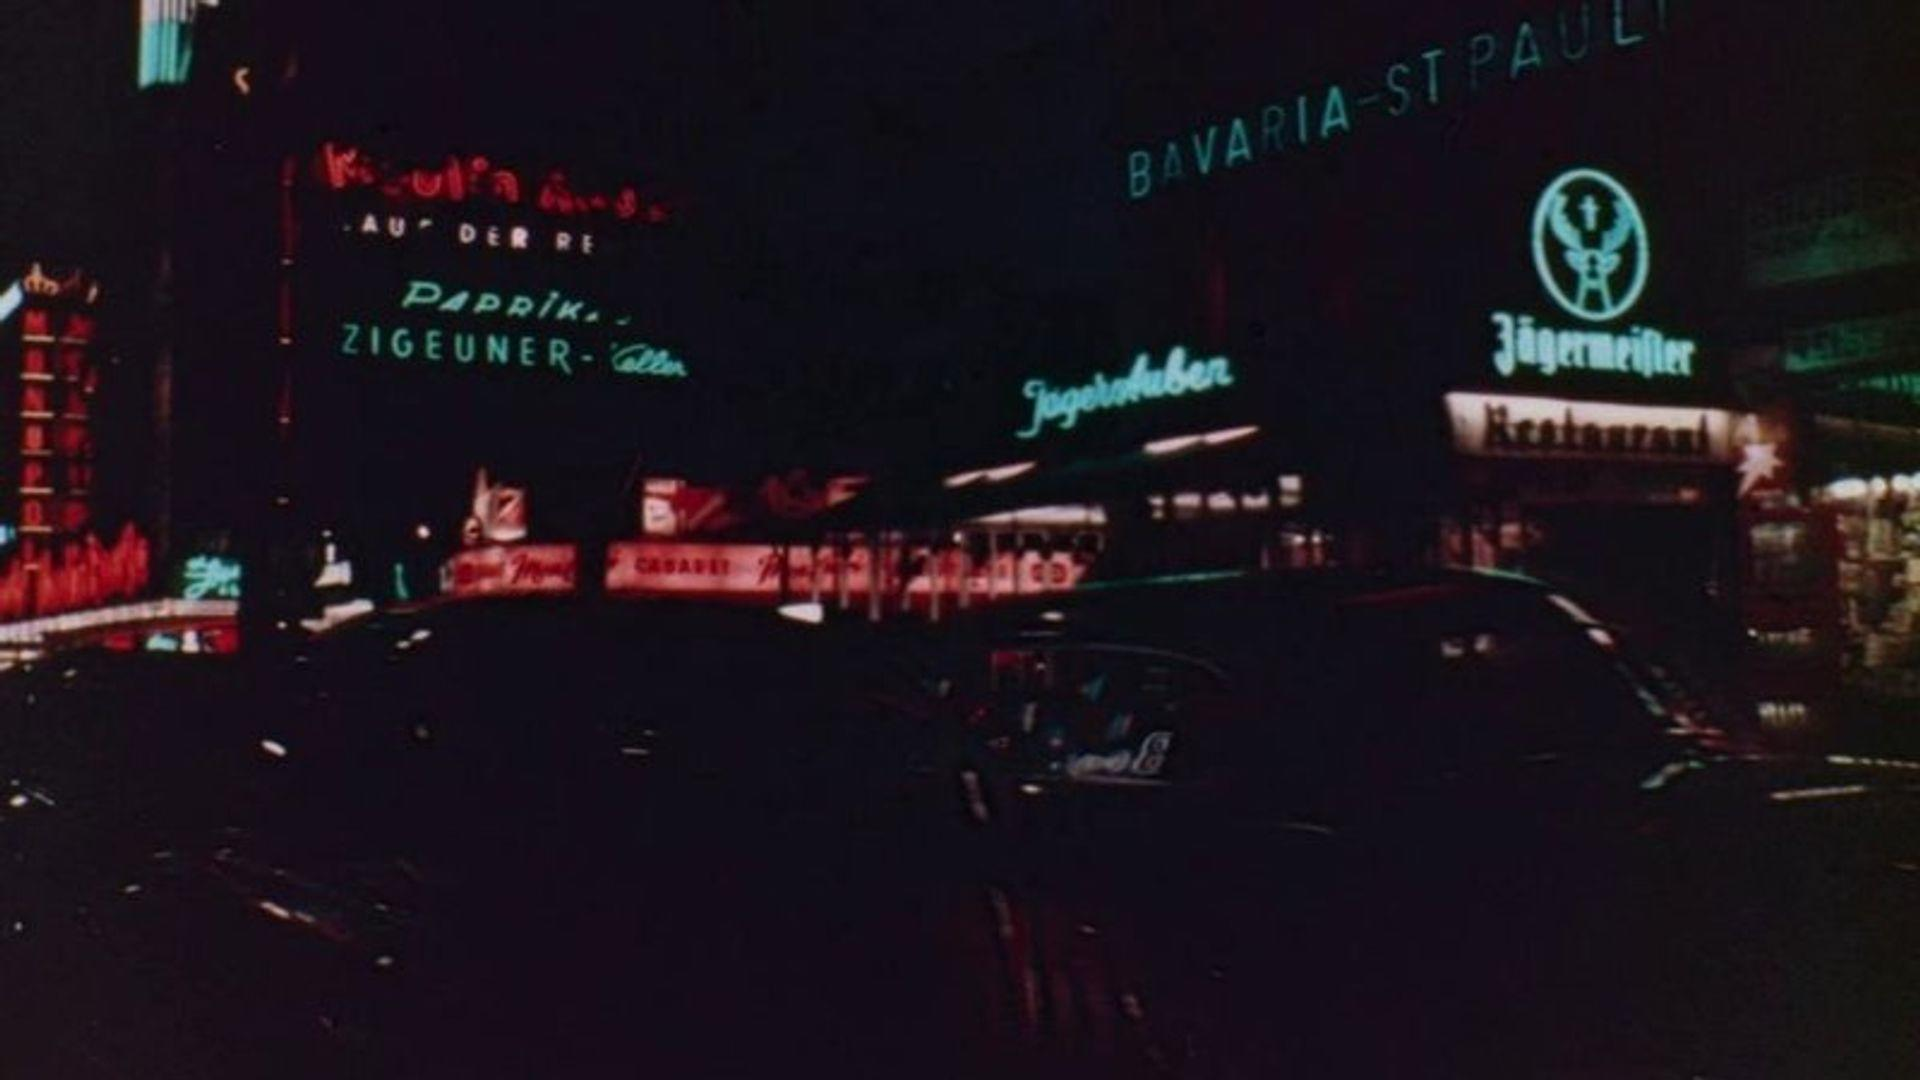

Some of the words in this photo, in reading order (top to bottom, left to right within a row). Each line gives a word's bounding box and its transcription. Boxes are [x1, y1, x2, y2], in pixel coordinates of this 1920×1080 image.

[457, 223, 529, 251] DER
[342, 323, 594, 376] ZIGEUNER-
[1484, 402, 1710, 455] Restaurant
